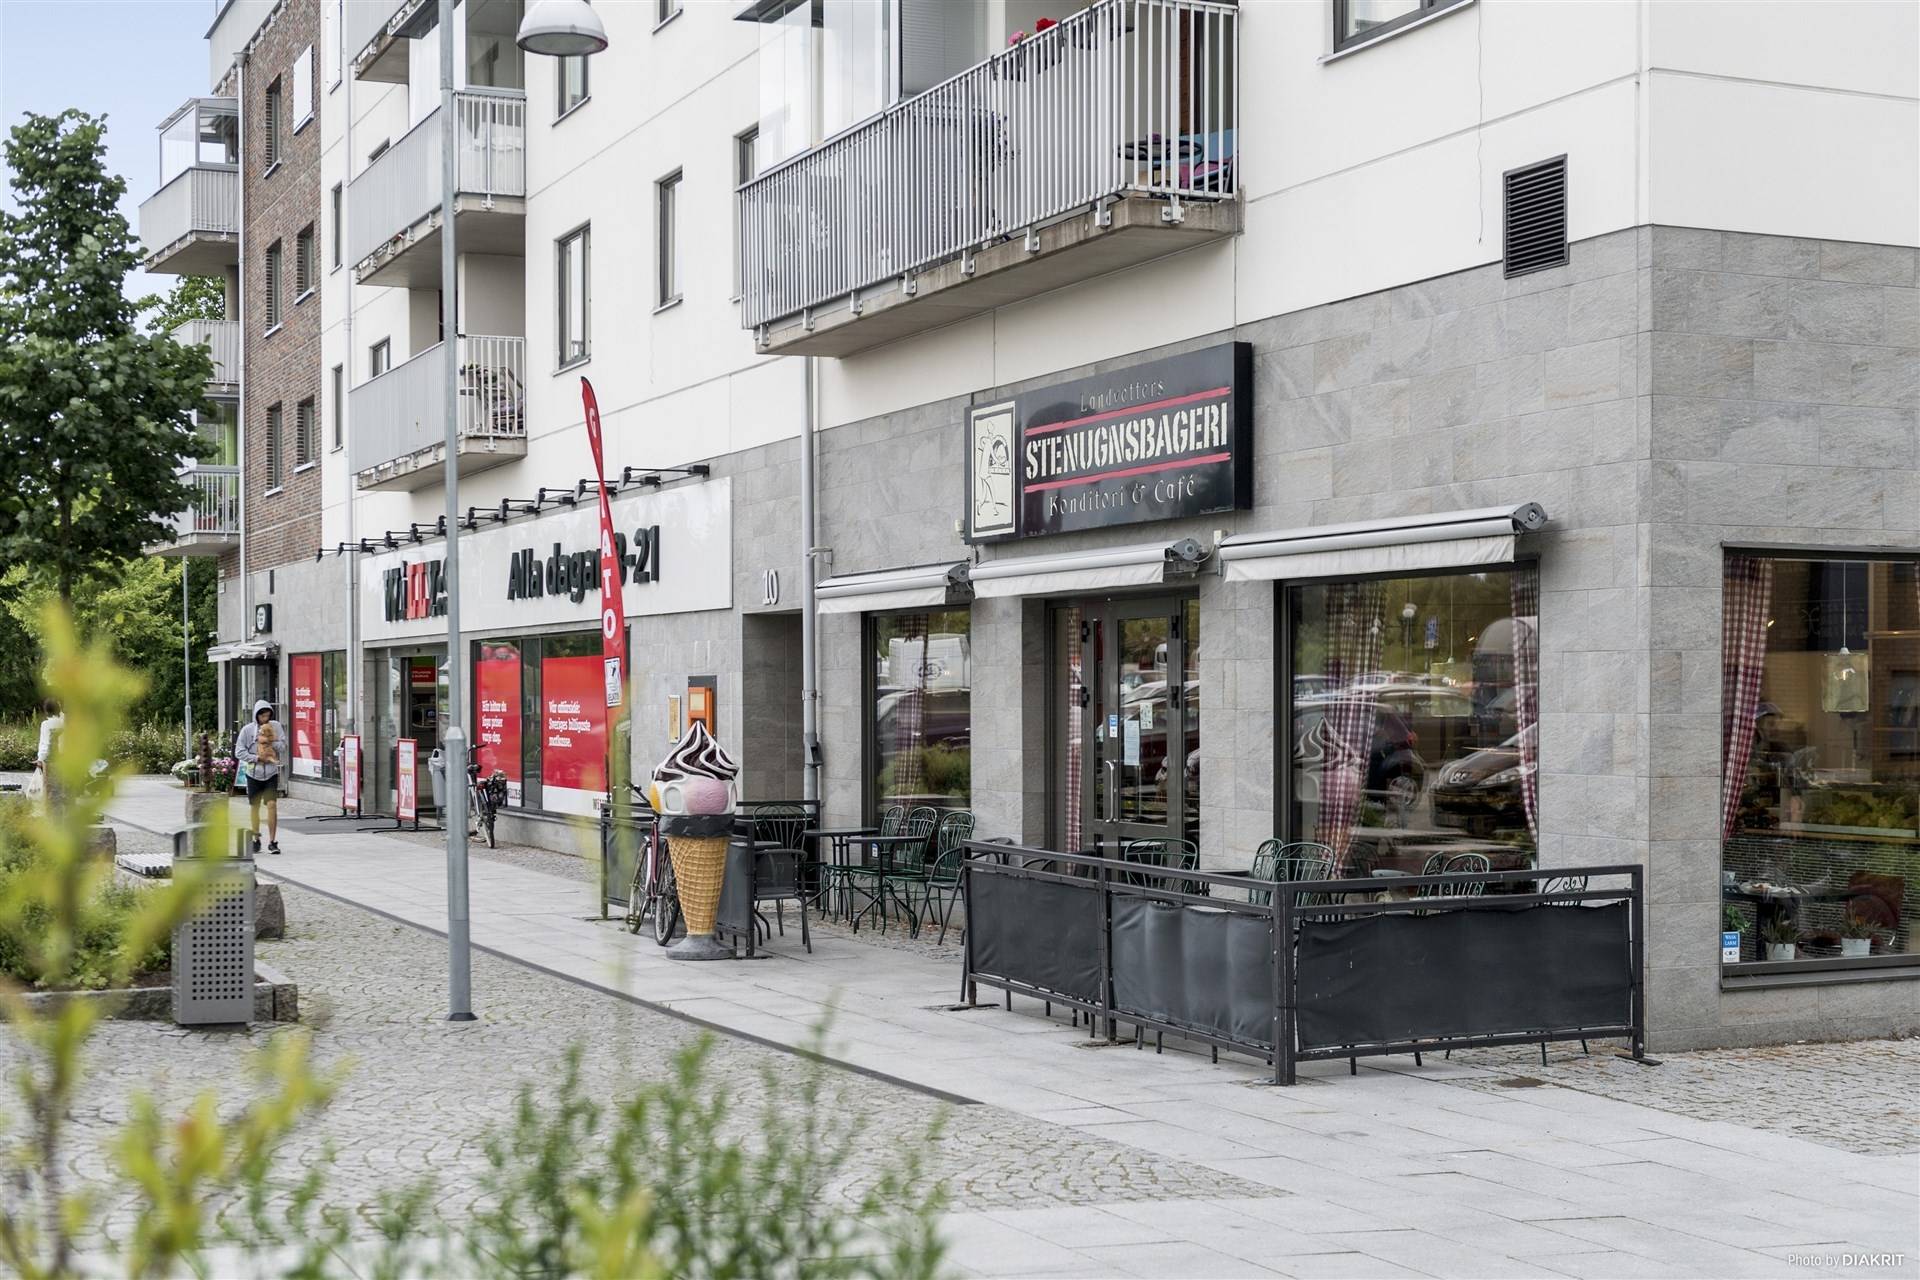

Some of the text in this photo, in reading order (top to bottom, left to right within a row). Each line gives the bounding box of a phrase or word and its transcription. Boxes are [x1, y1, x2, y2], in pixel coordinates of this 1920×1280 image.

[1080, 380, 1165, 412] Landvetters
[1025, 402, 1228, 480] STENUGNSBAGERI
[1050, 474, 1195, 516] Konditori & Café
[507, 548, 544, 600] Alla
[762, 568, 780, 606] 10
